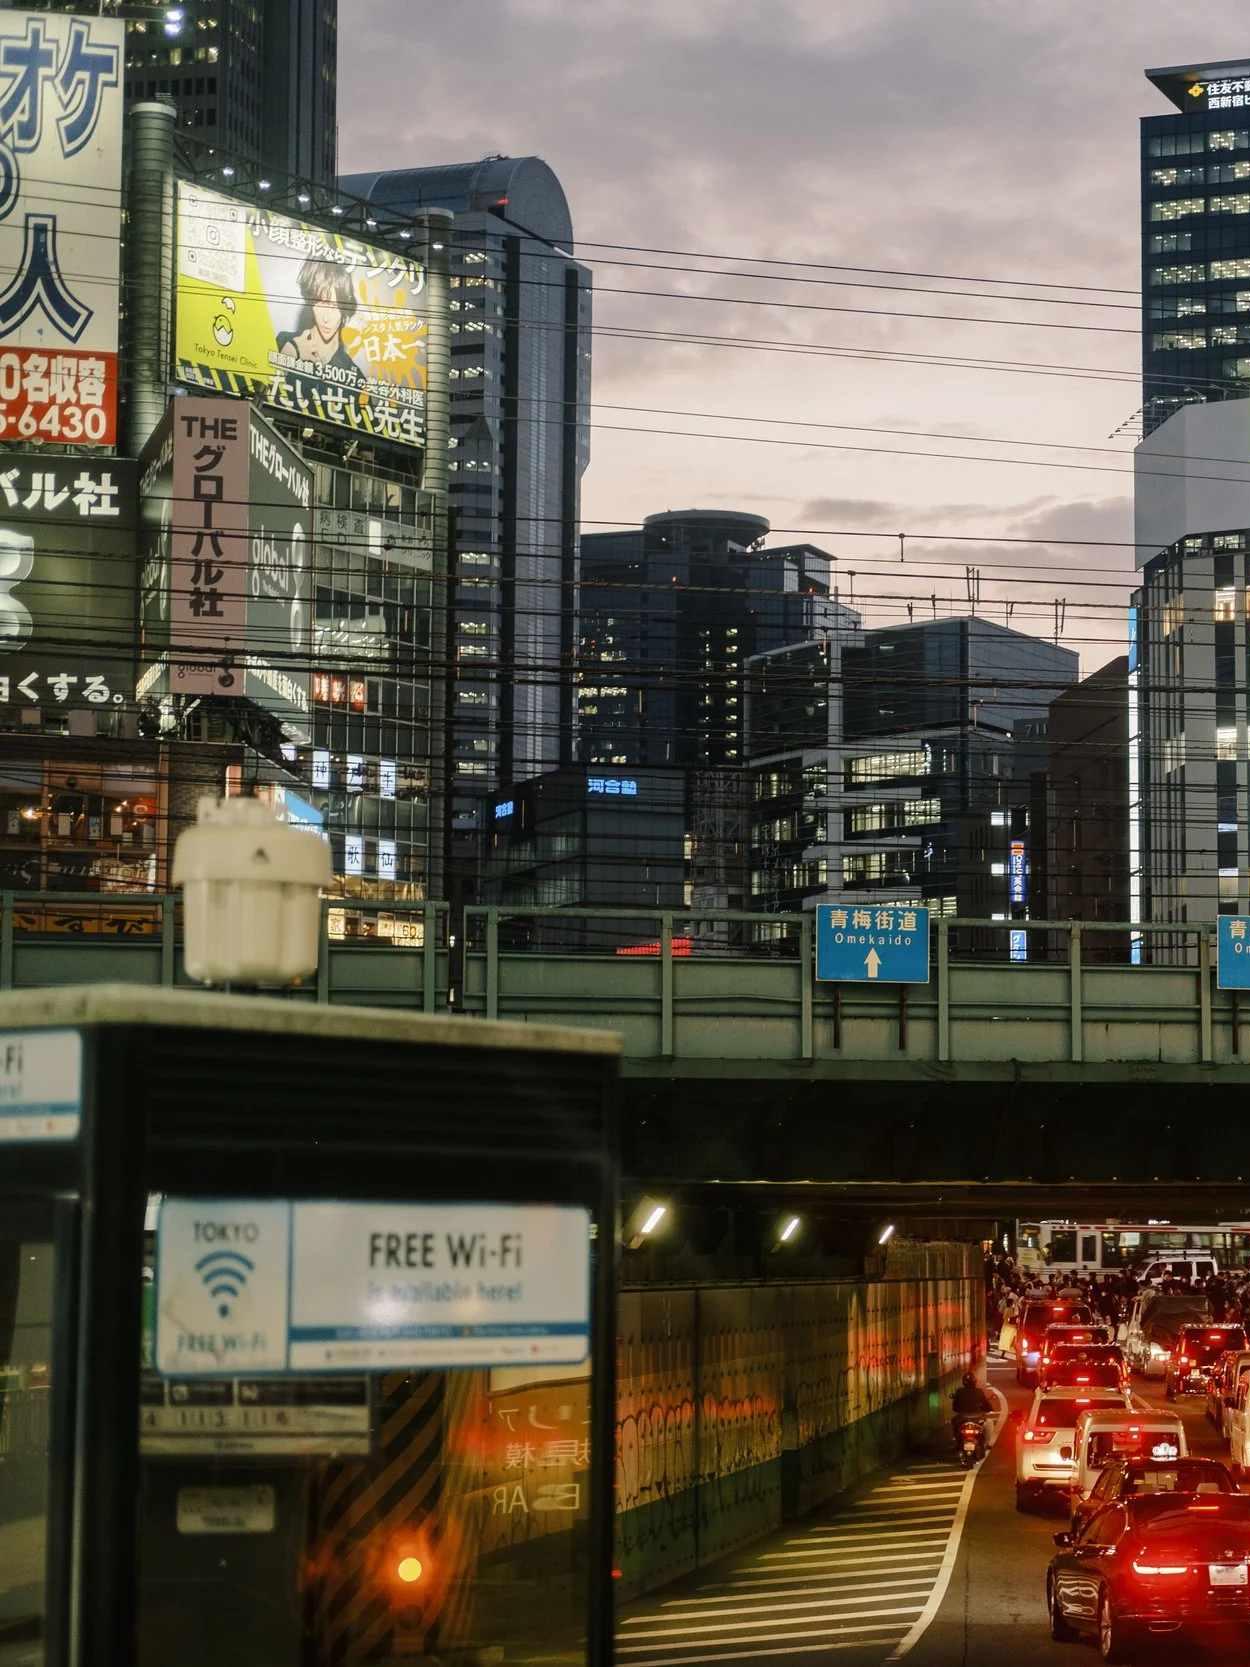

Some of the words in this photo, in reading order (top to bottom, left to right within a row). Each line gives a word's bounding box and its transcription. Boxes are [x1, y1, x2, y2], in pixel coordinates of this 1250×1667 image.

[194, 343, 216, 357] Tokyo
[217, 349, 238, 363] Tensei
[239, 356, 258, 369] Clinic
[268, 370, 426, 445] たいせい先生
[588, 778, 637, 796] 河合塾
[829, 909, 917, 932] 青梅街道
[834, 932, 912, 945] Omekaido
[193, 1221, 260, 1243] TOKYO
[368, 1232, 436, 1268] FREE
[445, 1232, 523, 1268] Wi-Fi
[177, 1333, 215, 1352] FREE
[221, 1332, 268, 1351] Wi-Fi
